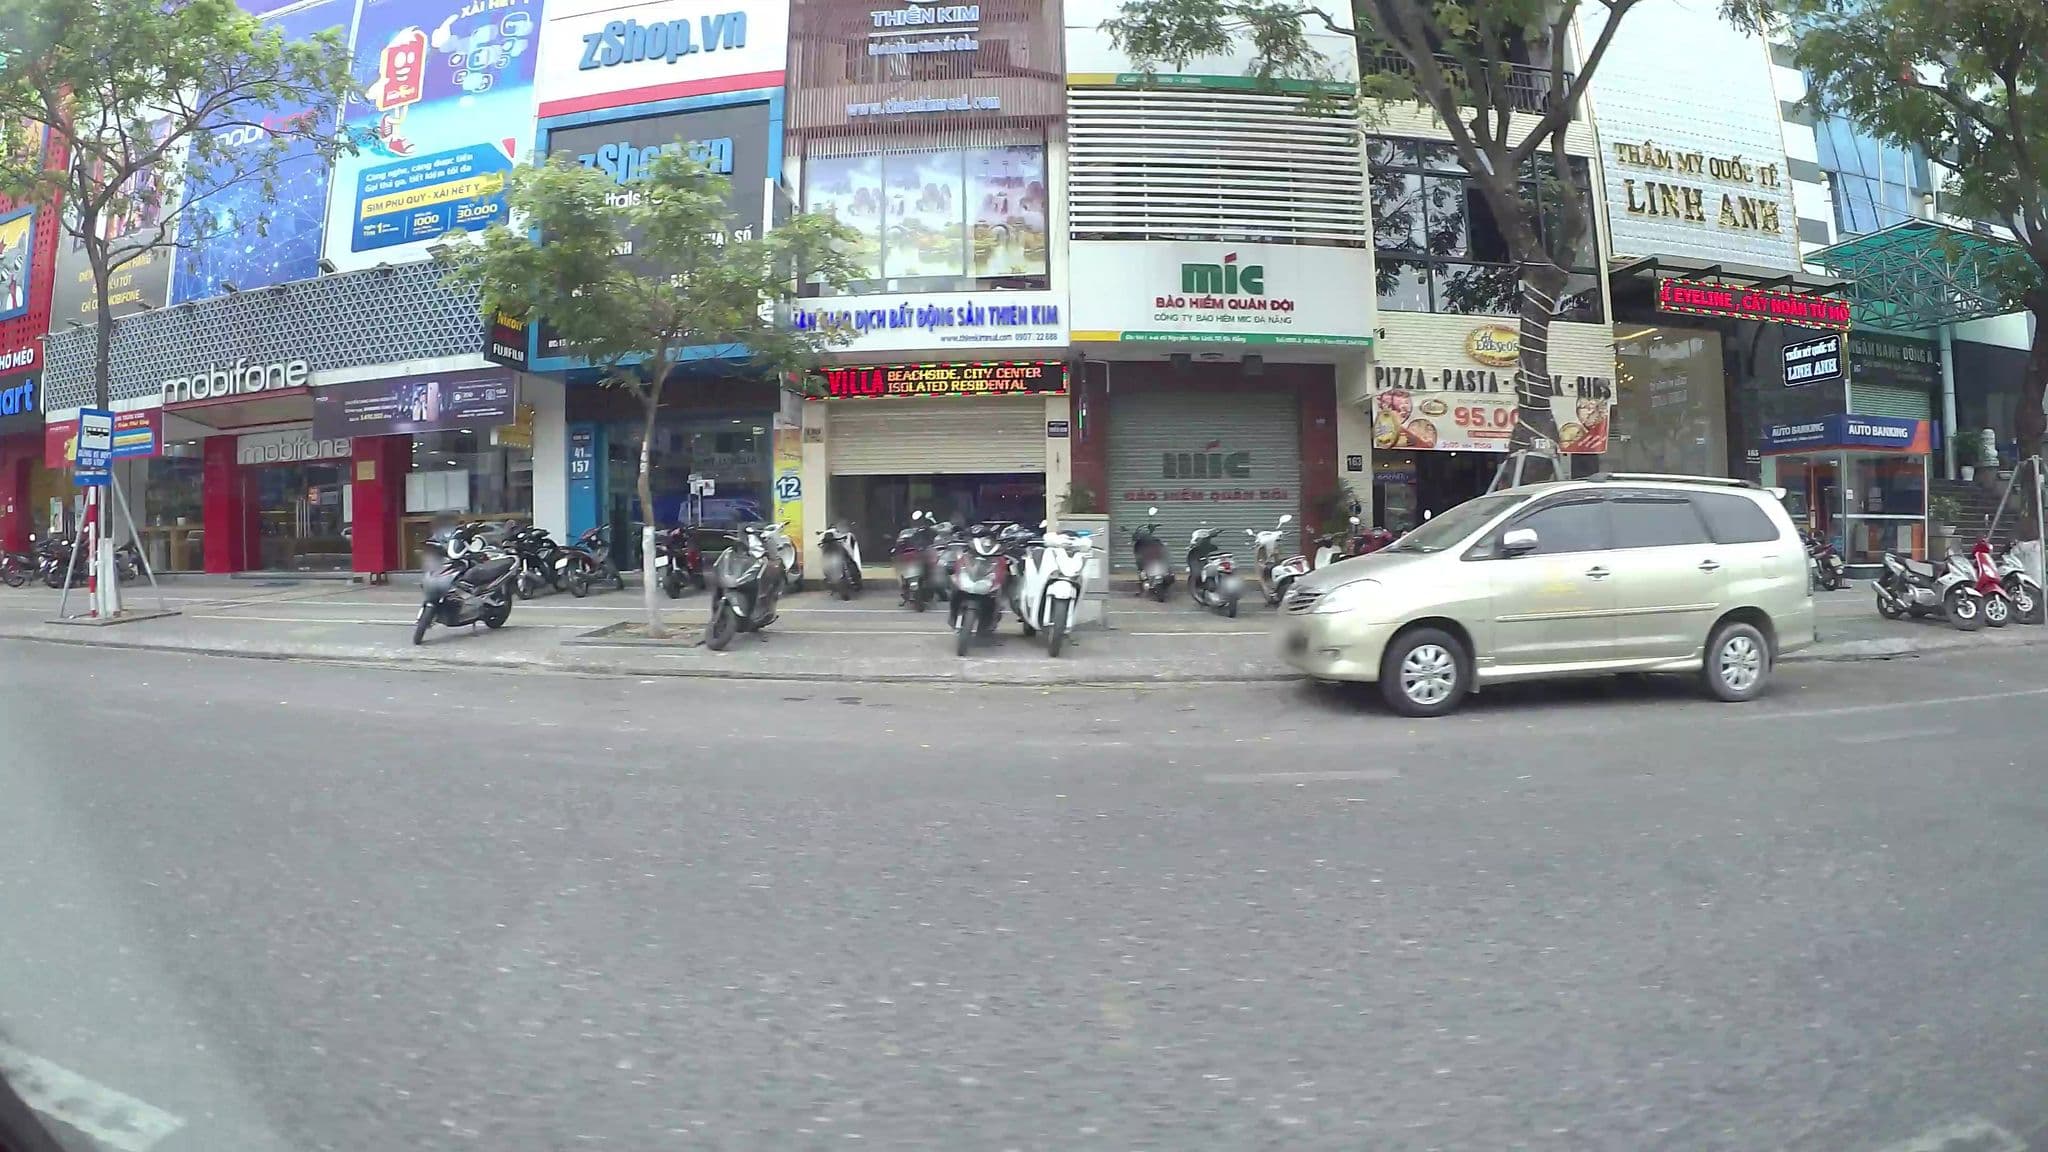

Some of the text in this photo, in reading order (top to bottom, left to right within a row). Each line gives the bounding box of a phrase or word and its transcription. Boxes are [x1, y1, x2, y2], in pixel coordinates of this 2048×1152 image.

[871, 4, 980, 27] THIÊN KIM
[1624, 178, 1783, 234] LINH ANH
[1228, 297, 1267, 311] QUÂN
[1270, 298, 1294, 313] ĐỘI
[855, 309, 886, 334] DỊCH
[889, 301, 914, 328] BẤT
[916, 304, 954, 332] ĐỘNG
[1031, 305, 1059, 326] KIM
[1182, 314, 1193, 322] TY
[493, 343, 524, 361] FUJIFILM
[964, 368, 992, 380] CITY
[997, 368, 1042, 379] CENTER
[1787, 358, 1838, 380] LINH ANH
[163, 358, 308, 404] mobifone
[827, 370, 885, 395] VILLA
[888, 381, 948, 393] ISOLATED
[1375, 366, 1426, 390] PIZZA
[1443, 368, 1499, 393] PASTA
[1772, 423, 1824, 437] AUTO BANKING
[1848, 424, 1908, 438] AUTO BANKING
[243, 435, 352, 462] mobifone
[572, 460, 590, 473] 157
[778, 477, 800, 497] 12
